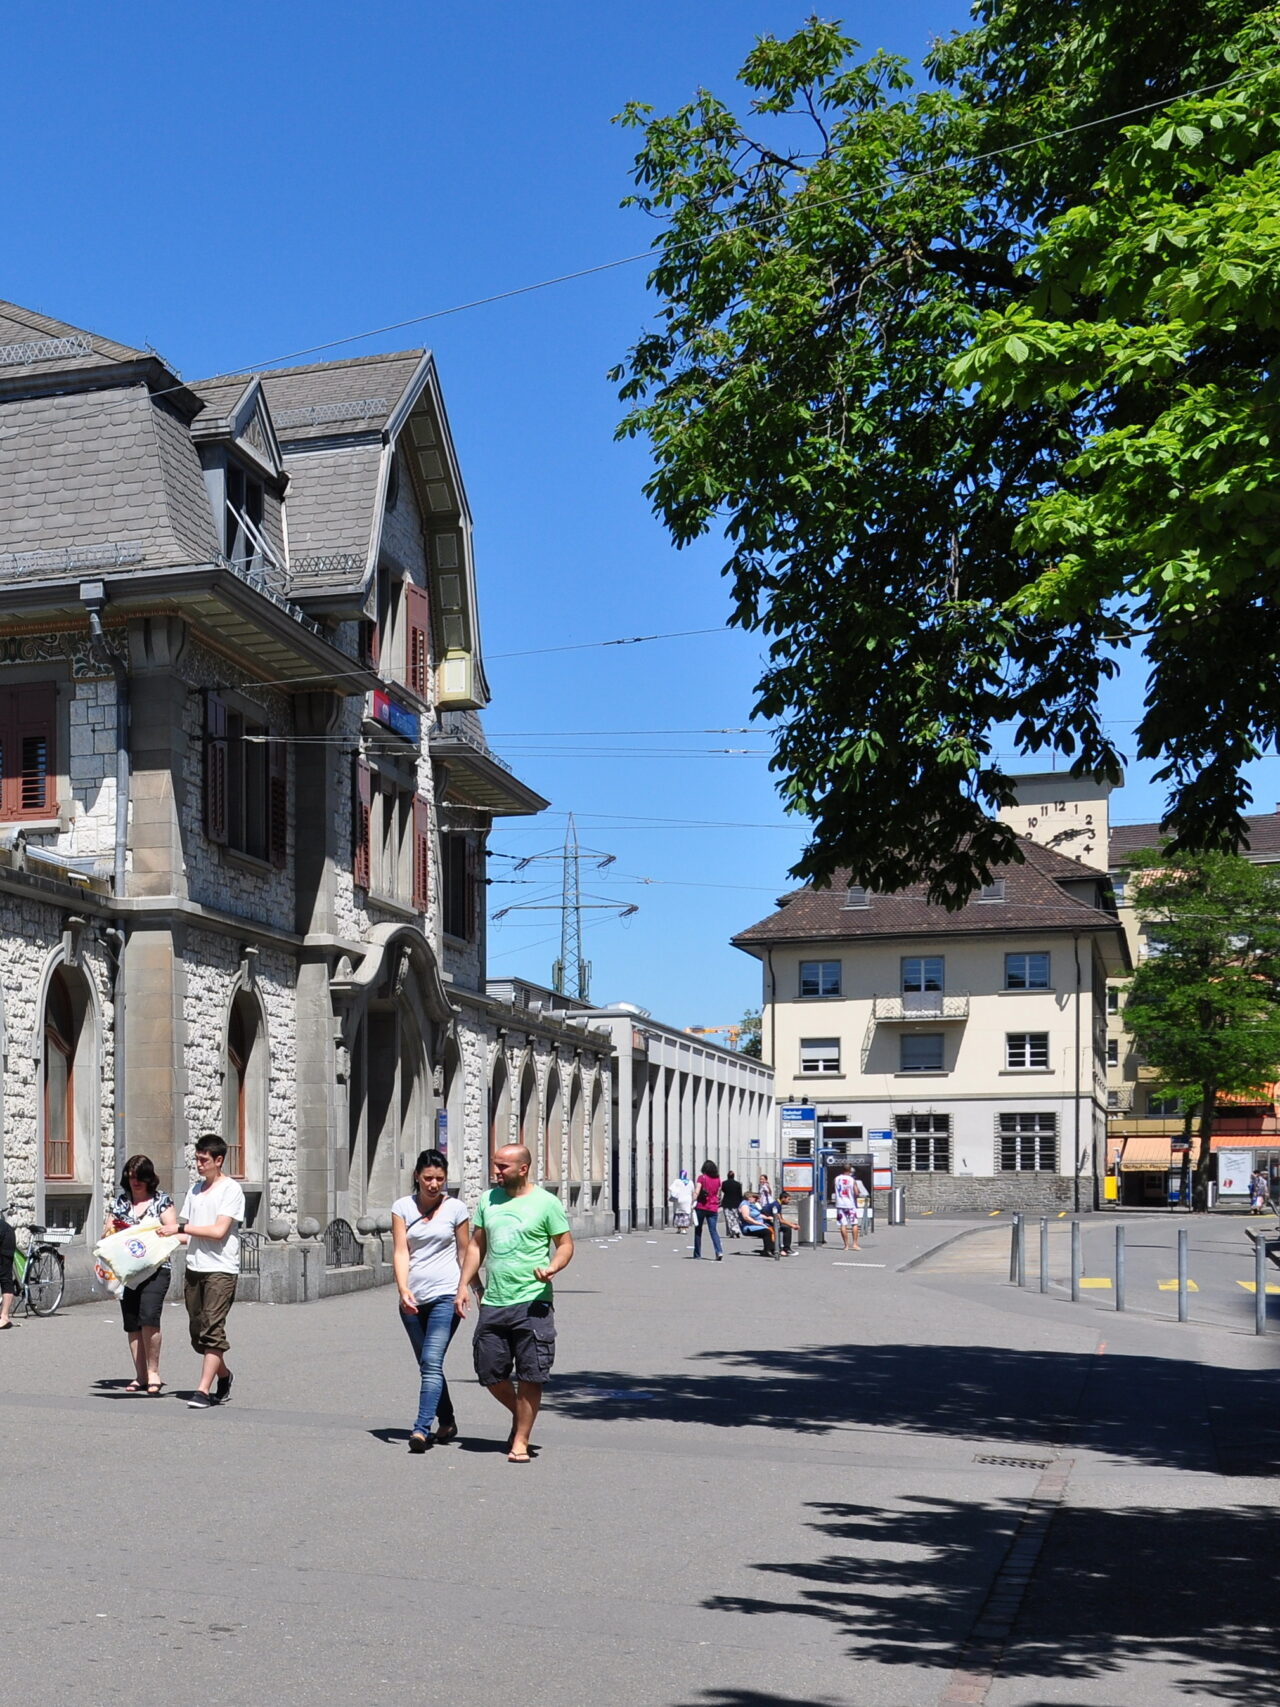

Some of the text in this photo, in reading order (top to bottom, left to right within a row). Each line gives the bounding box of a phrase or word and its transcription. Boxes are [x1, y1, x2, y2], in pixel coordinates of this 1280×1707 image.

[1041, 806, 1048, 817] 11
[1054, 801, 1066, 812] 12
[1074, 804, 1078, 815] 1
[1027, 817, 1038, 828] 10
[1085, 814, 1093, 825] 2
[1087, 829, 1096, 840] 3
[1083, 844, 1094, 854] 4
